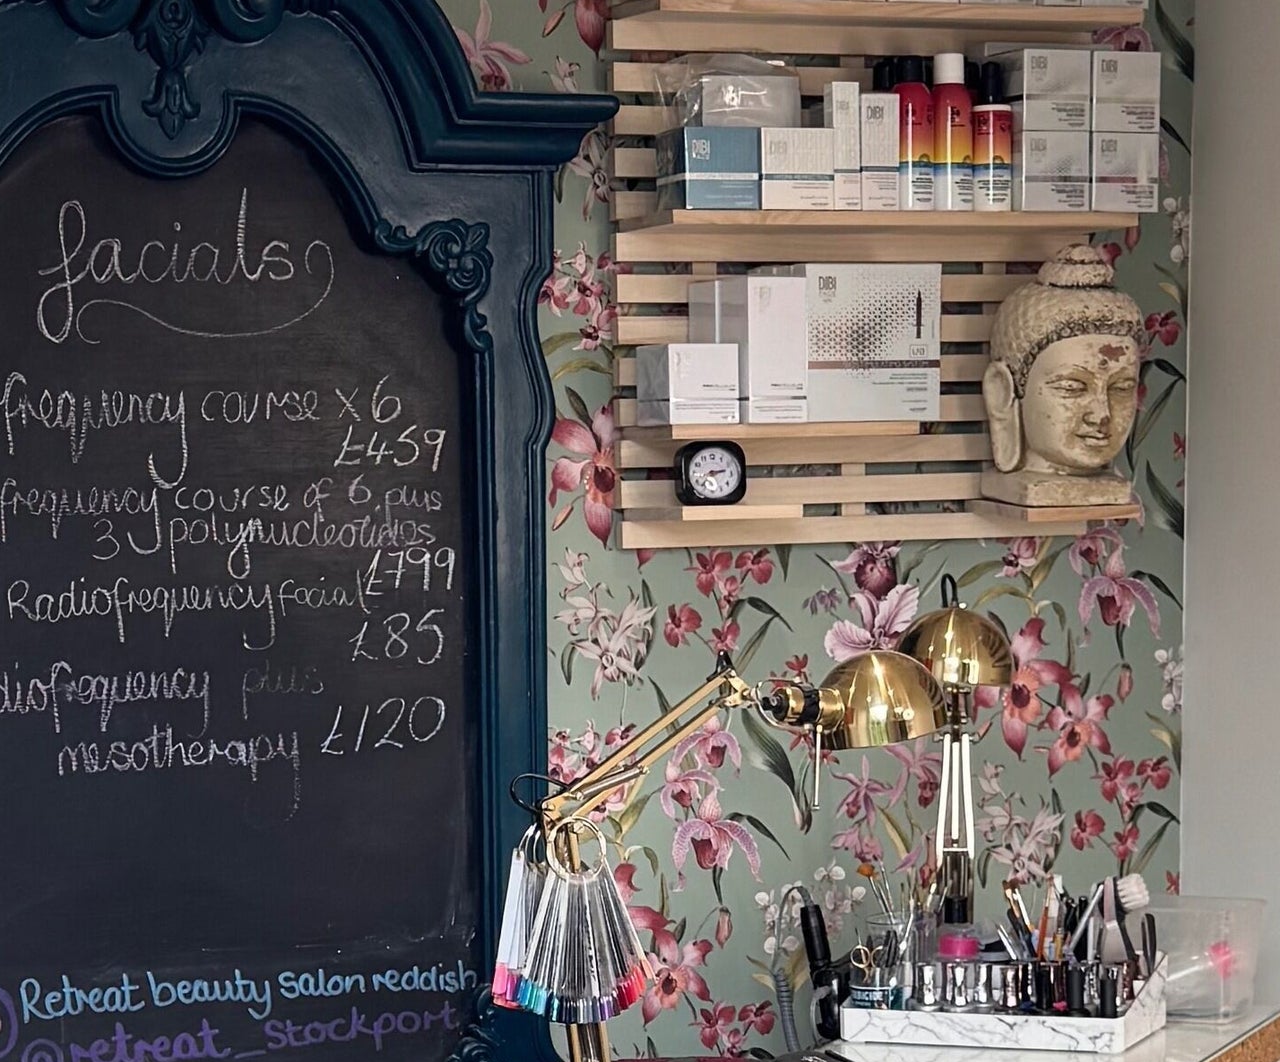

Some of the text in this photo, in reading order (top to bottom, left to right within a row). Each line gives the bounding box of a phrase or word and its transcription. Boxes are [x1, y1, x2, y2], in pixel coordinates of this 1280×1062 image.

[867, 106, 884, 119] DIBI
[37, 187, 295, 343] facials
[819, 276, 837, 290] DIBI
[201, 386, 320, 423] course
[371, 374, 402, 423] 6
[333, 424, 447, 473] £459
[175, 485, 290, 512] course
[303, 477, 333, 522] of
[385, 485, 443, 528] plus
[92, 508, 437, 580] 3 polynucleotides
[362, 546, 456, 596] £799
[7, 569, 371, 650] Radiofrequency facial
[348, 608, 446, 665] £85
[58, 697, 446, 822] mesotherapy £120
[20, 973, 145, 1023] Retreat
[146, 966, 272, 1020] beauty
[371, 960, 478, 993] reddish
